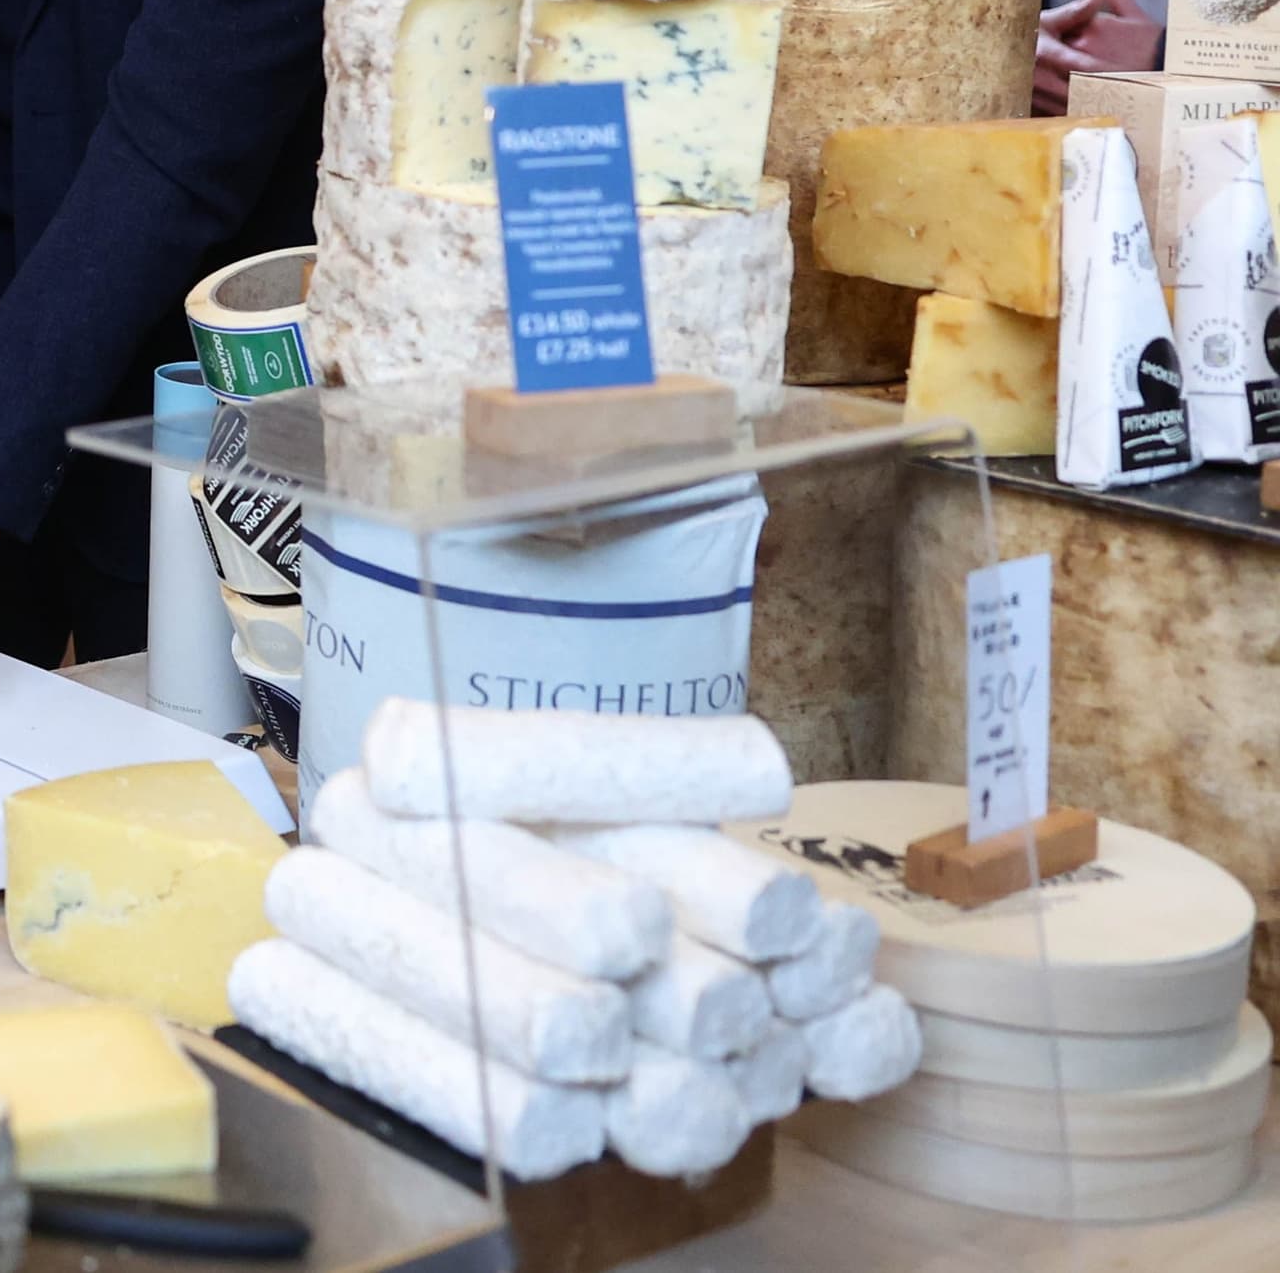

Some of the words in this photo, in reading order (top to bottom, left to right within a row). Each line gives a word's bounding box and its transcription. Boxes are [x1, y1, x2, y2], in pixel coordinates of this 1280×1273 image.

[1183, 39, 1231, 49] ARTISAN
[1235, 42, 1279, 53] BISCUIT
[1181, 100, 1280, 121] MILLER'
[497, 122, 622, 154] RAGSTONE
[1122, 409, 1185, 433] PITCHFORK
